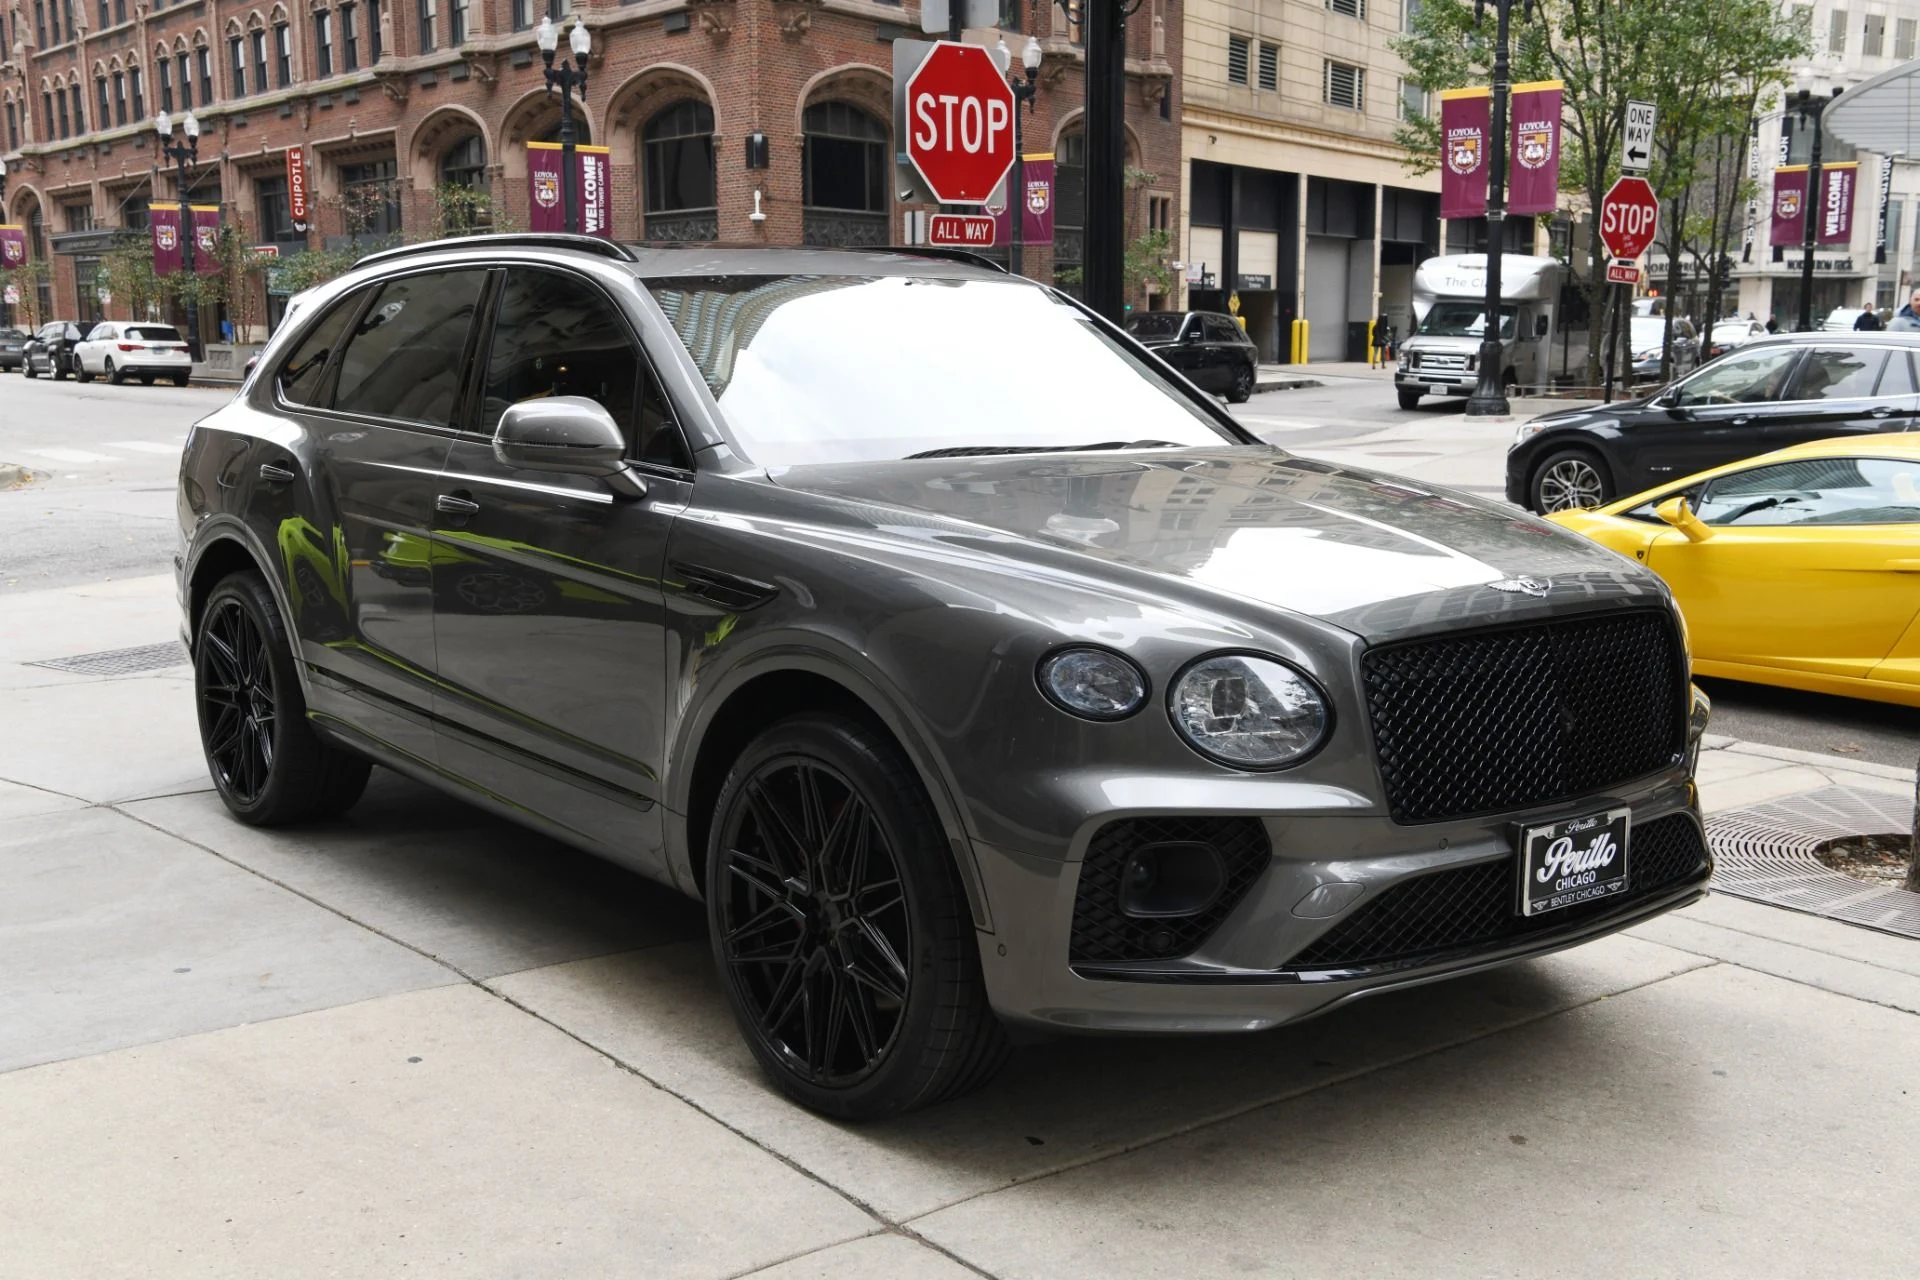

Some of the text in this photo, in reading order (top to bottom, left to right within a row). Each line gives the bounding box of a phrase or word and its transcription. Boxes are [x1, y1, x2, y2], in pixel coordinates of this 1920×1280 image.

[915, 92, 1008, 154] STOP
[1519, 121, 1553, 131] LOYOLA
[1630, 108, 1652, 125] ONE
[1448, 128, 1482, 137] LOYOLA
[1628, 126, 1651, 143] WAY
[291, 152, 304, 216] CHIPOTLE
[583, 155, 598, 233] WELCOME
[1825, 171, 1843, 236] WELCOME
[1604, 202, 1655, 235] STOP
[936, 222, 989, 240] ALL WAY
[1445, 276, 1467, 287] The
[1610, 268, 1636, 280] ALL WAY
[1565, 818, 1598, 833] Perillo
[1536, 832, 1617, 883] Perillo
[1555, 870, 1597, 891] CHICAGO
[1550, 885, 1605, 907] BENTLEY CHICAGO
